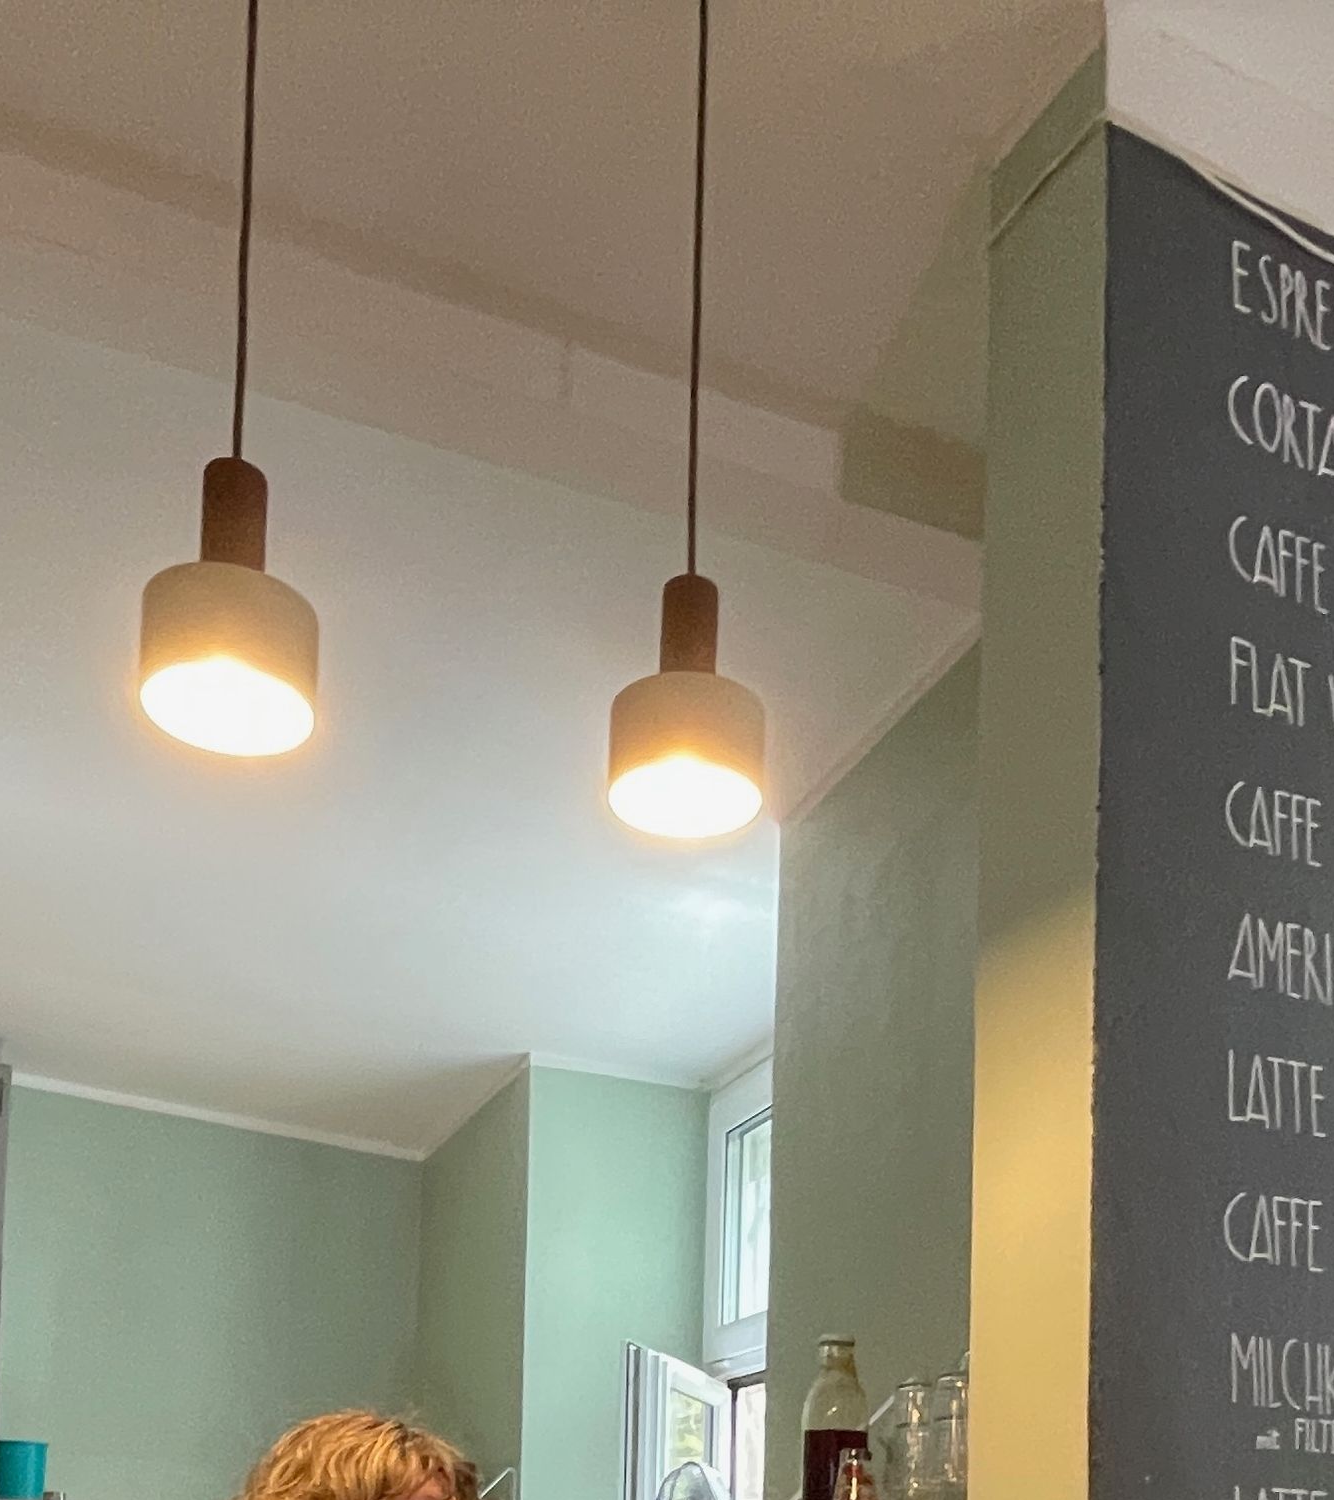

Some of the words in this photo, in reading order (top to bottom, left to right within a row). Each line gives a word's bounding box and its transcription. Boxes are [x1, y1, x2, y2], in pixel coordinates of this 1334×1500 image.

[1229, 515, 1329, 615] CAFFE
[1230, 635, 1313, 728] FLAT
[1225, 780, 1323, 868] CAFFE
[1228, 1048, 1327, 1138] LATTE
[1223, 1191, 1323, 1273] CAFFE
